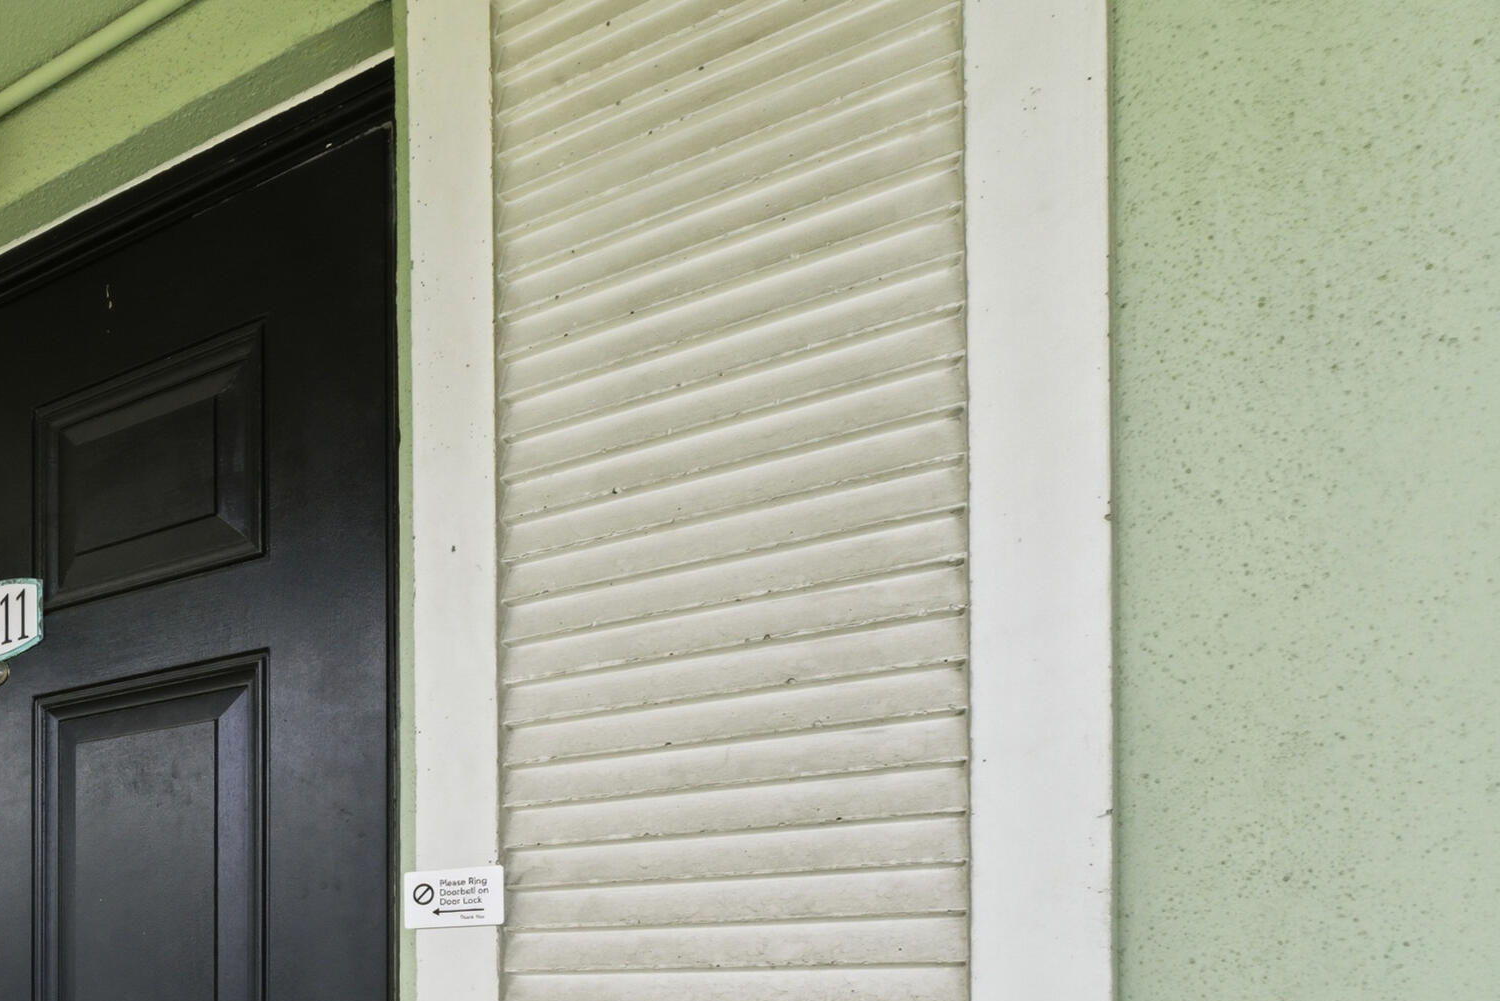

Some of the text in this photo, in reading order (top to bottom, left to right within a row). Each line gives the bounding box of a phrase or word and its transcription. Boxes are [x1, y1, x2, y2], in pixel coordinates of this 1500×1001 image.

[440, 877, 488, 887] Please Ring
[440, 887, 476, 897] Doorbell
[440, 896, 482, 906] Door Lock
